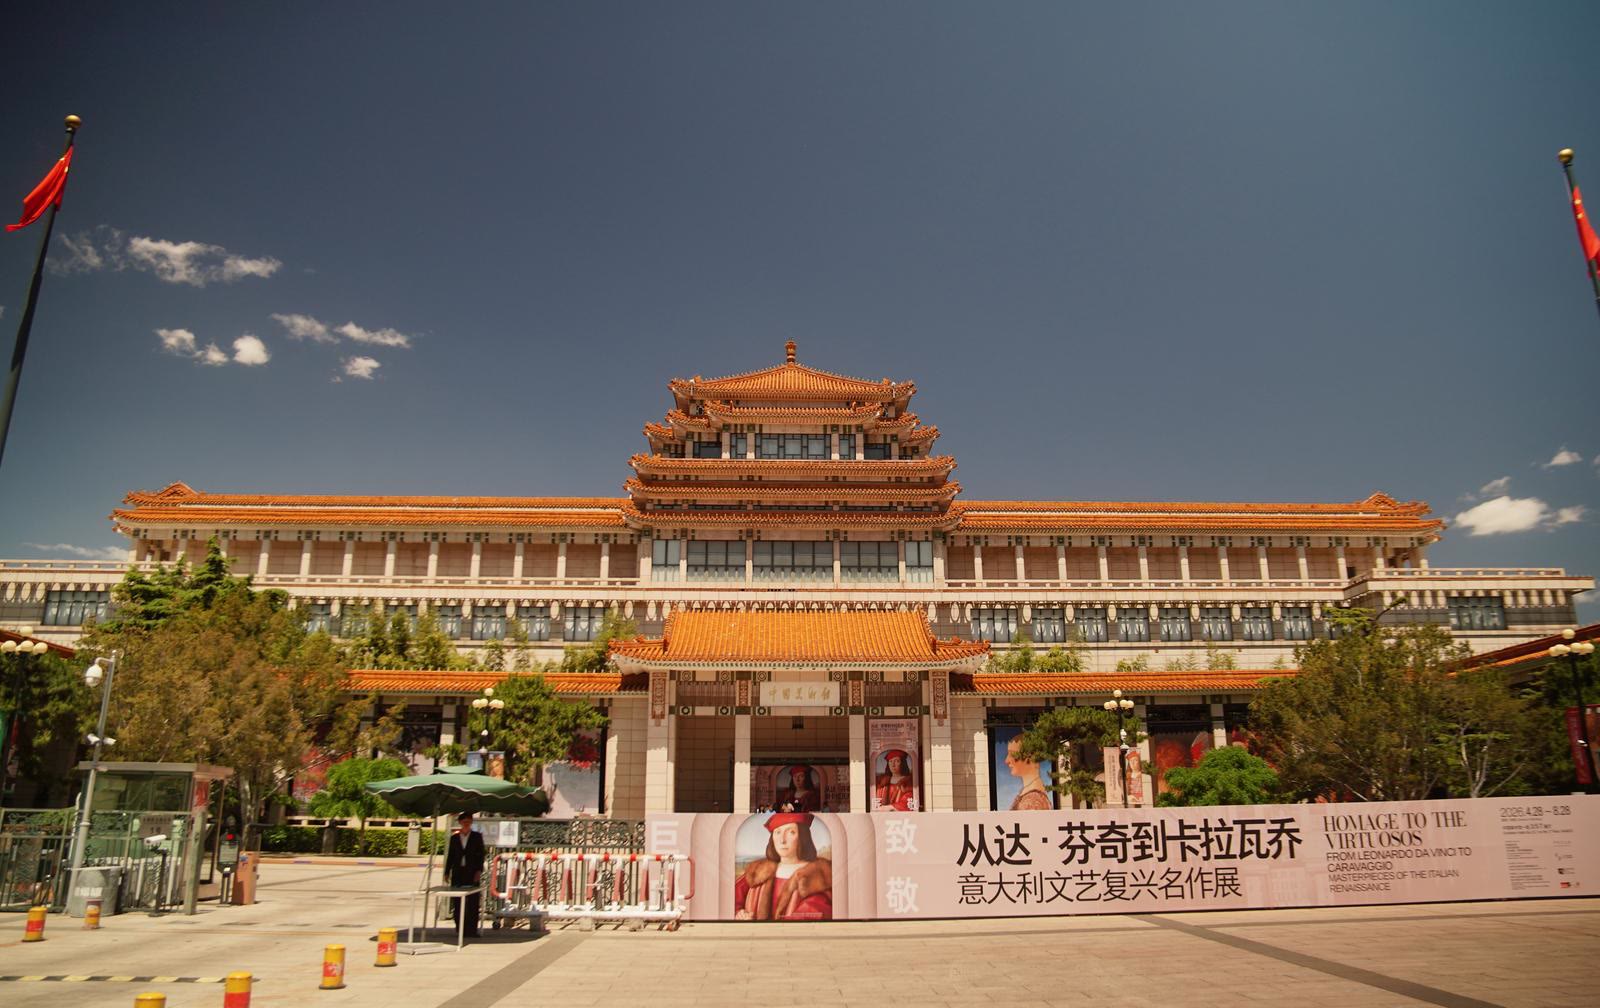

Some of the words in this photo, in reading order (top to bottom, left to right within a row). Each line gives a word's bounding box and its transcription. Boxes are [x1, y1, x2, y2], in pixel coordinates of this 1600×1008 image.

[1323, 813, 1399, 832] HOMAGE
[1402, 812, 1427, 829] TO
[1432, 811, 1467, 828] THE
[1325, 830, 1423, 849] VIRTUOSOS
[1326, 851, 1355, 861] FROM
[1358, 849, 1414, 860] LEONARDO
[1415, 848, 1429, 858] DA
[1432, 847, 1456, 857] VINCI
[1459, 846, 1473, 857] TO
[1327, 861, 1393, 873] CARAVAGGIO
[1328, 871, 1395, 882] MASTERPIECES
[1396, 871, 1408, 880] OF
[1410, 870, 1427, 879] THE
[1428, 869, 1460, 878] ITALIAN
[957, 866, 1243, 905] 意大利文艺复兴名作展
[1329, 882, 1391, 893] RENAISSANCE
